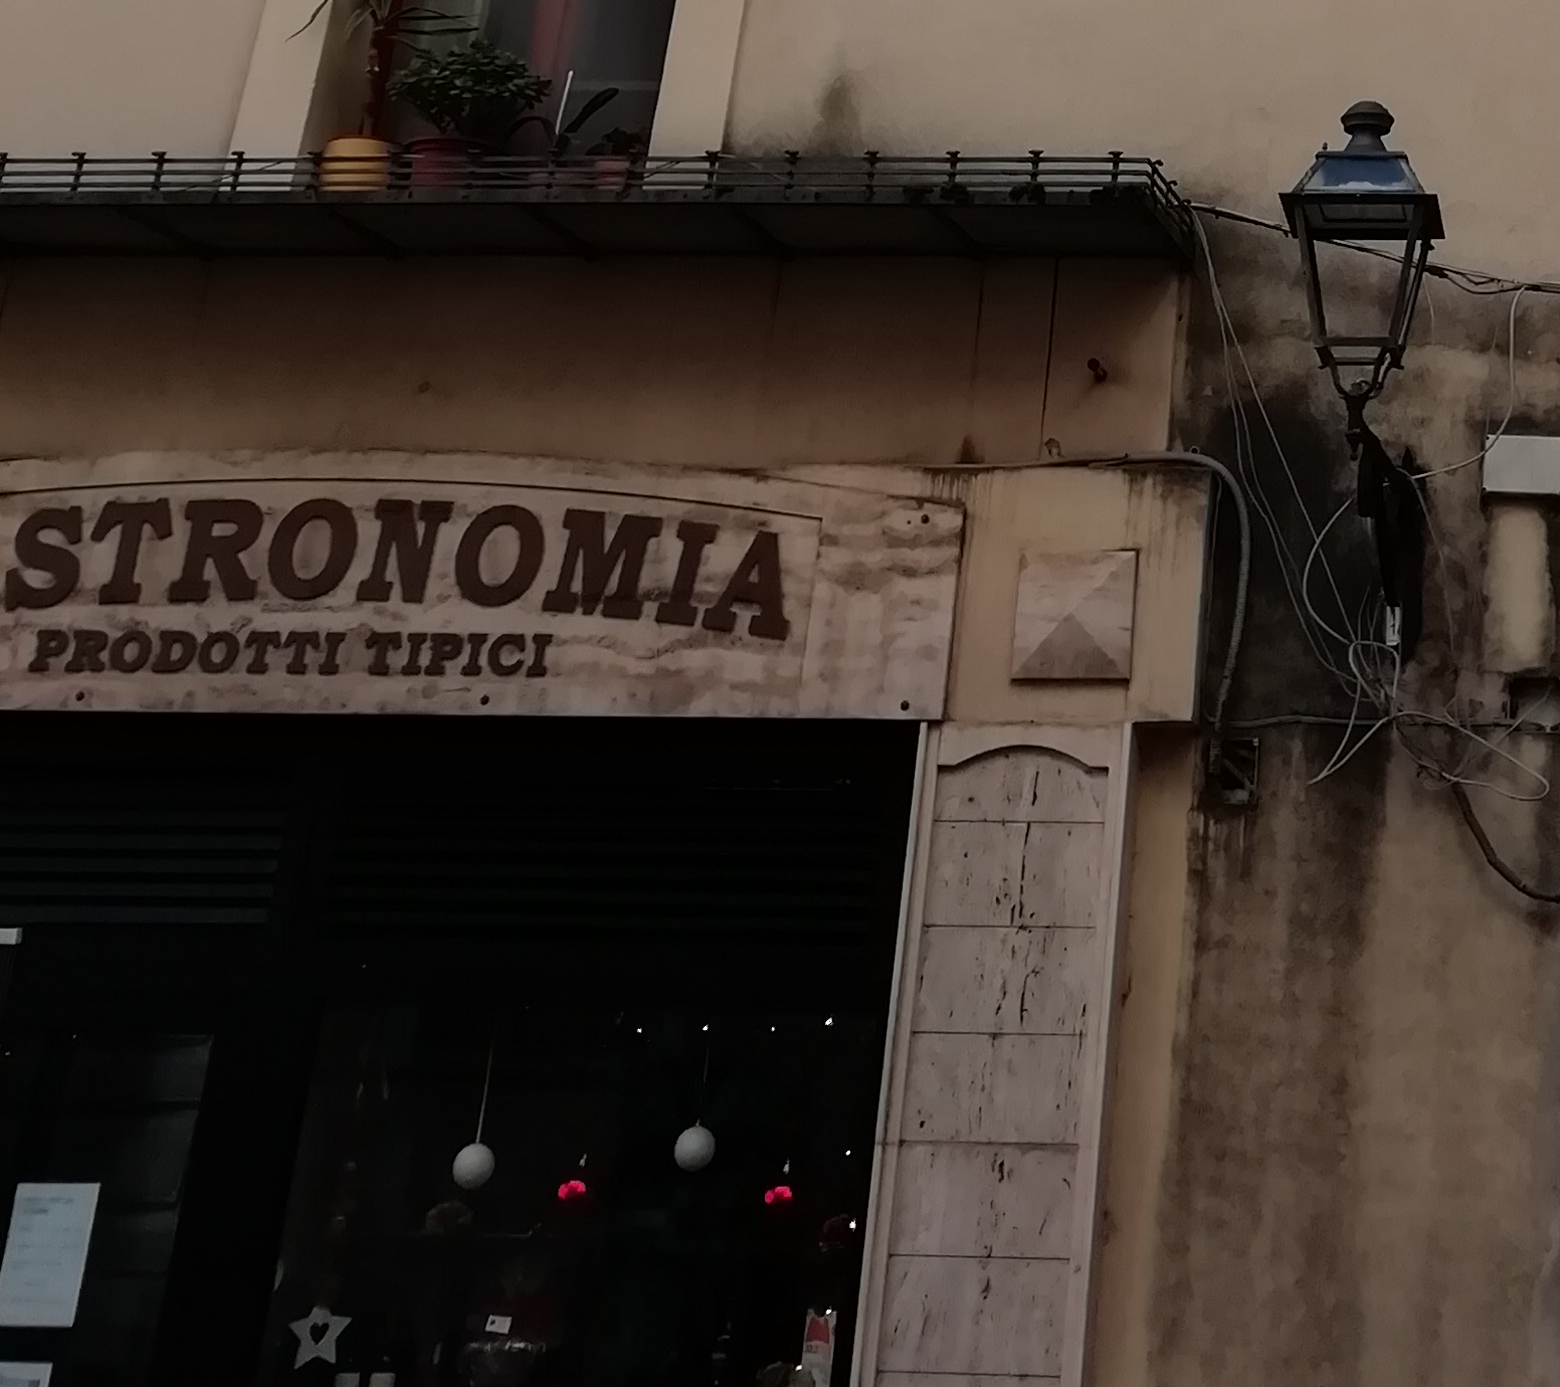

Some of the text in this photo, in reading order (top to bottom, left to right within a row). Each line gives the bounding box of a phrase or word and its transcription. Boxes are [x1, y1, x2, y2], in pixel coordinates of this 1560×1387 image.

[4, 498, 792, 640] STRONOMIA
[28, 629, 553, 678] PRODOTTI TIPICI
